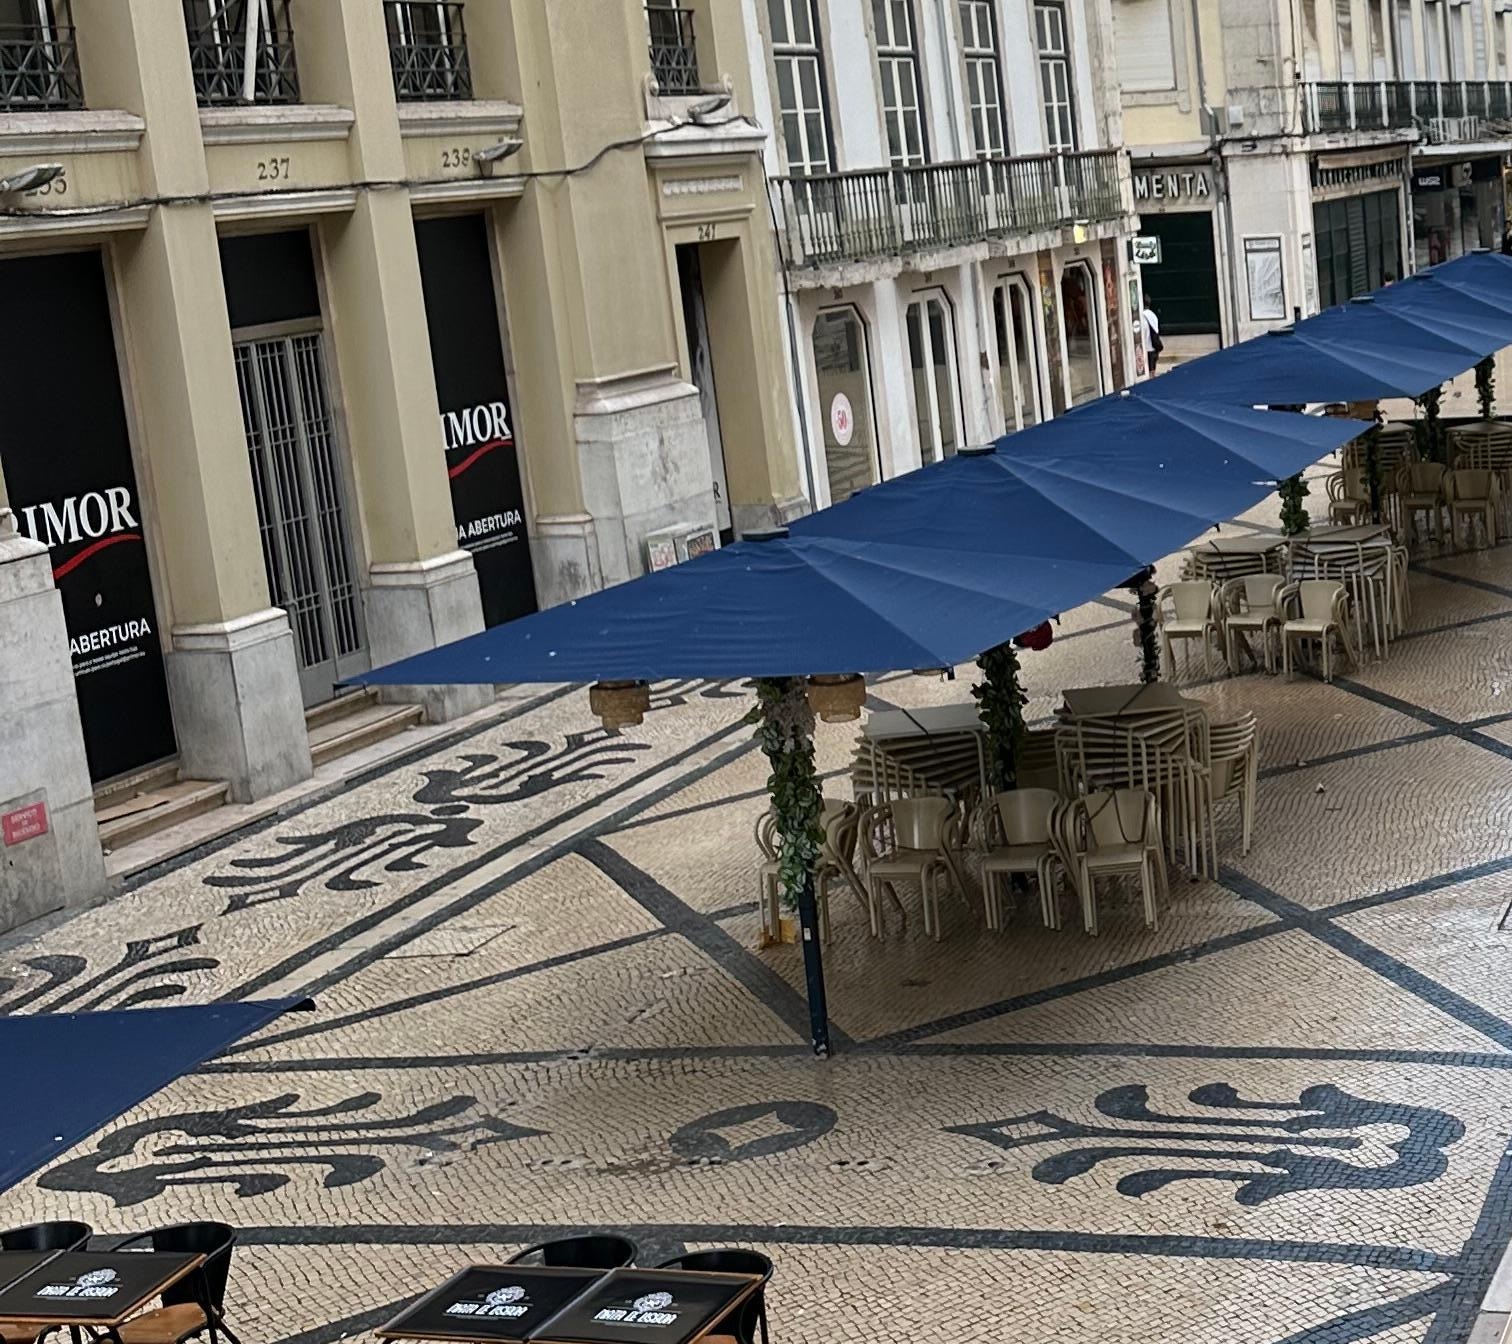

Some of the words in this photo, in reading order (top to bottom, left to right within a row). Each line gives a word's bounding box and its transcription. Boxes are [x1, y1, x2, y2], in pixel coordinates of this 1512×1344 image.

[257, 157, 290, 180] 237
[442, 147, 470, 168] 239
[1134, 172, 1208, 199] MENTA
[11, 486, 138, 547] IMOR
[468, 509, 522, 540] ABERTURA
[70, 617, 151, 655] ABERTURA
